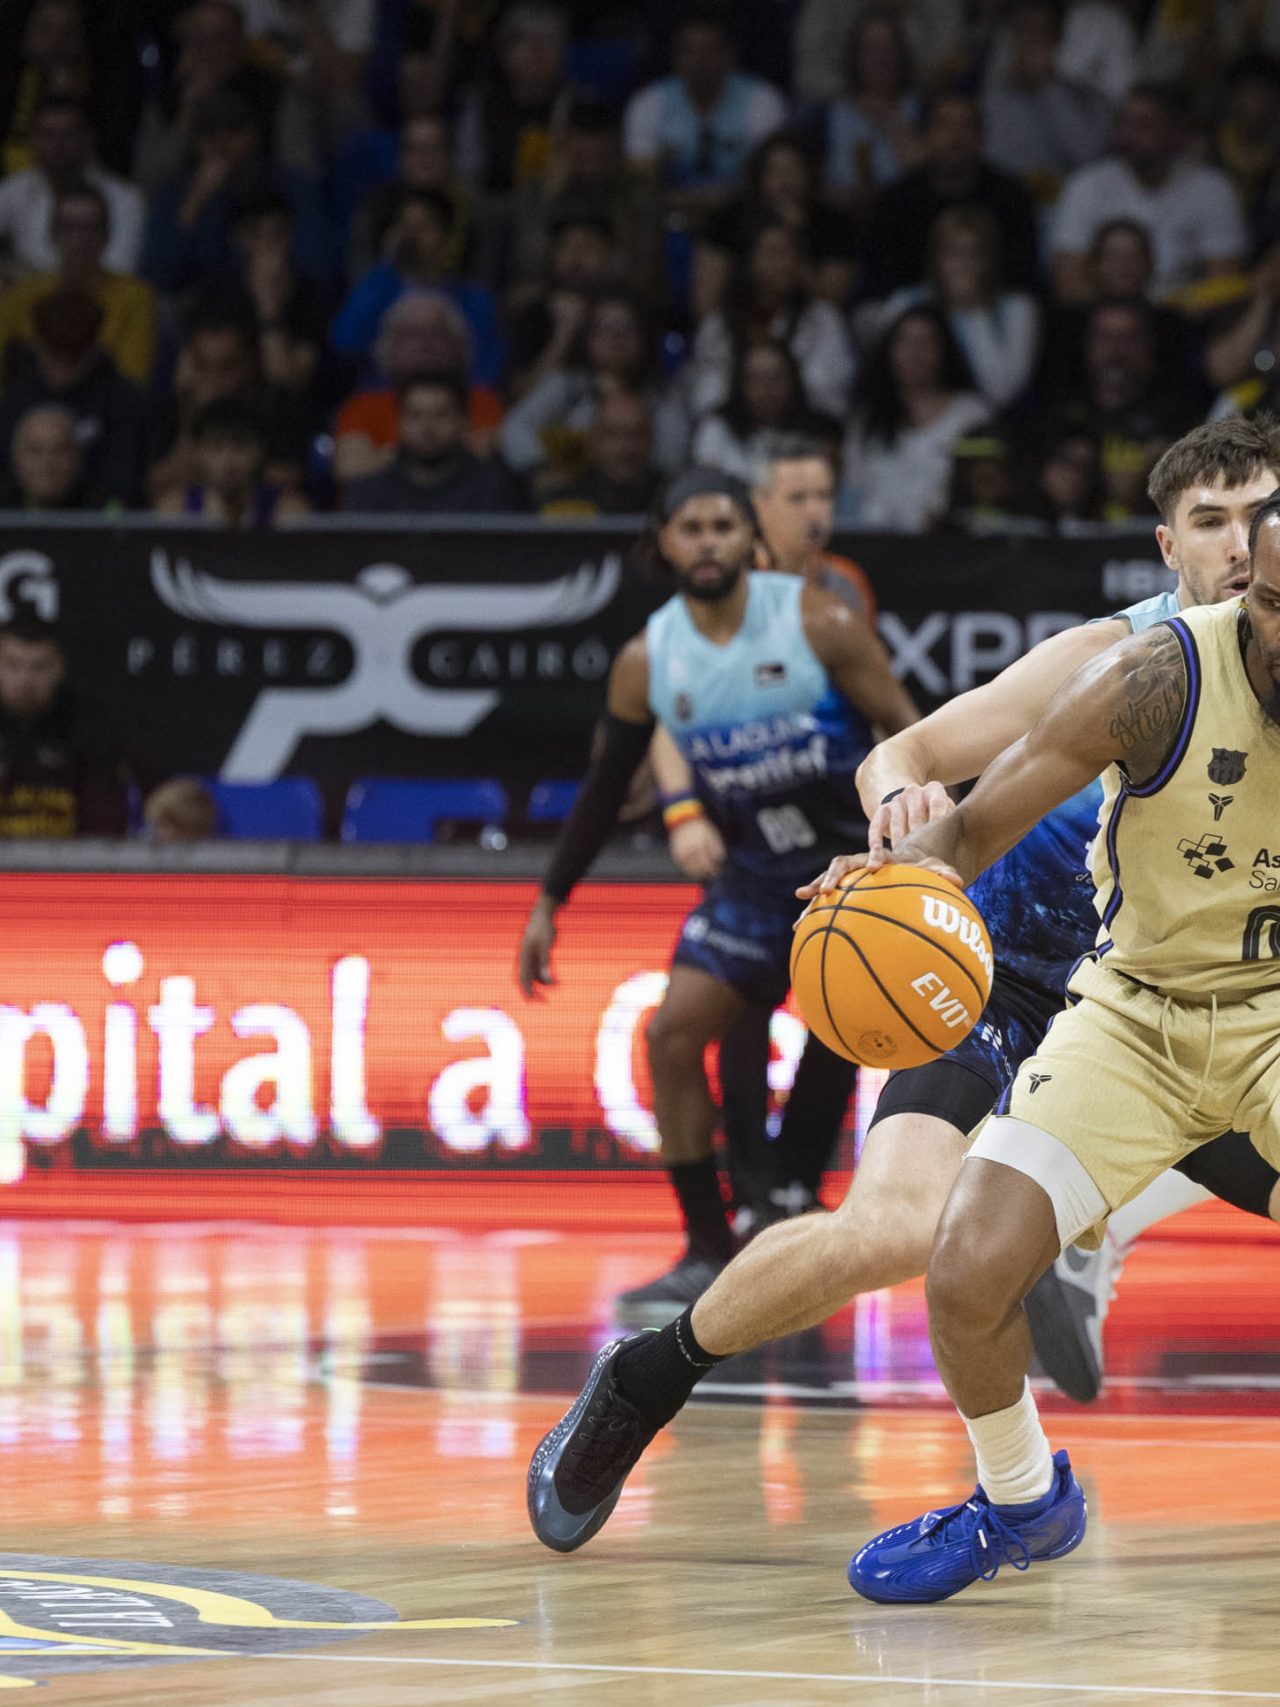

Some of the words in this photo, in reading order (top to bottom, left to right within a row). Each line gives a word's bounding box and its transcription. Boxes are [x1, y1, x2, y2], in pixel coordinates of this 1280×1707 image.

[128, 632, 336, 676] PÉREZ
[910, 971, 969, 1029] EVO
[428, 1007, 531, 1152] a
